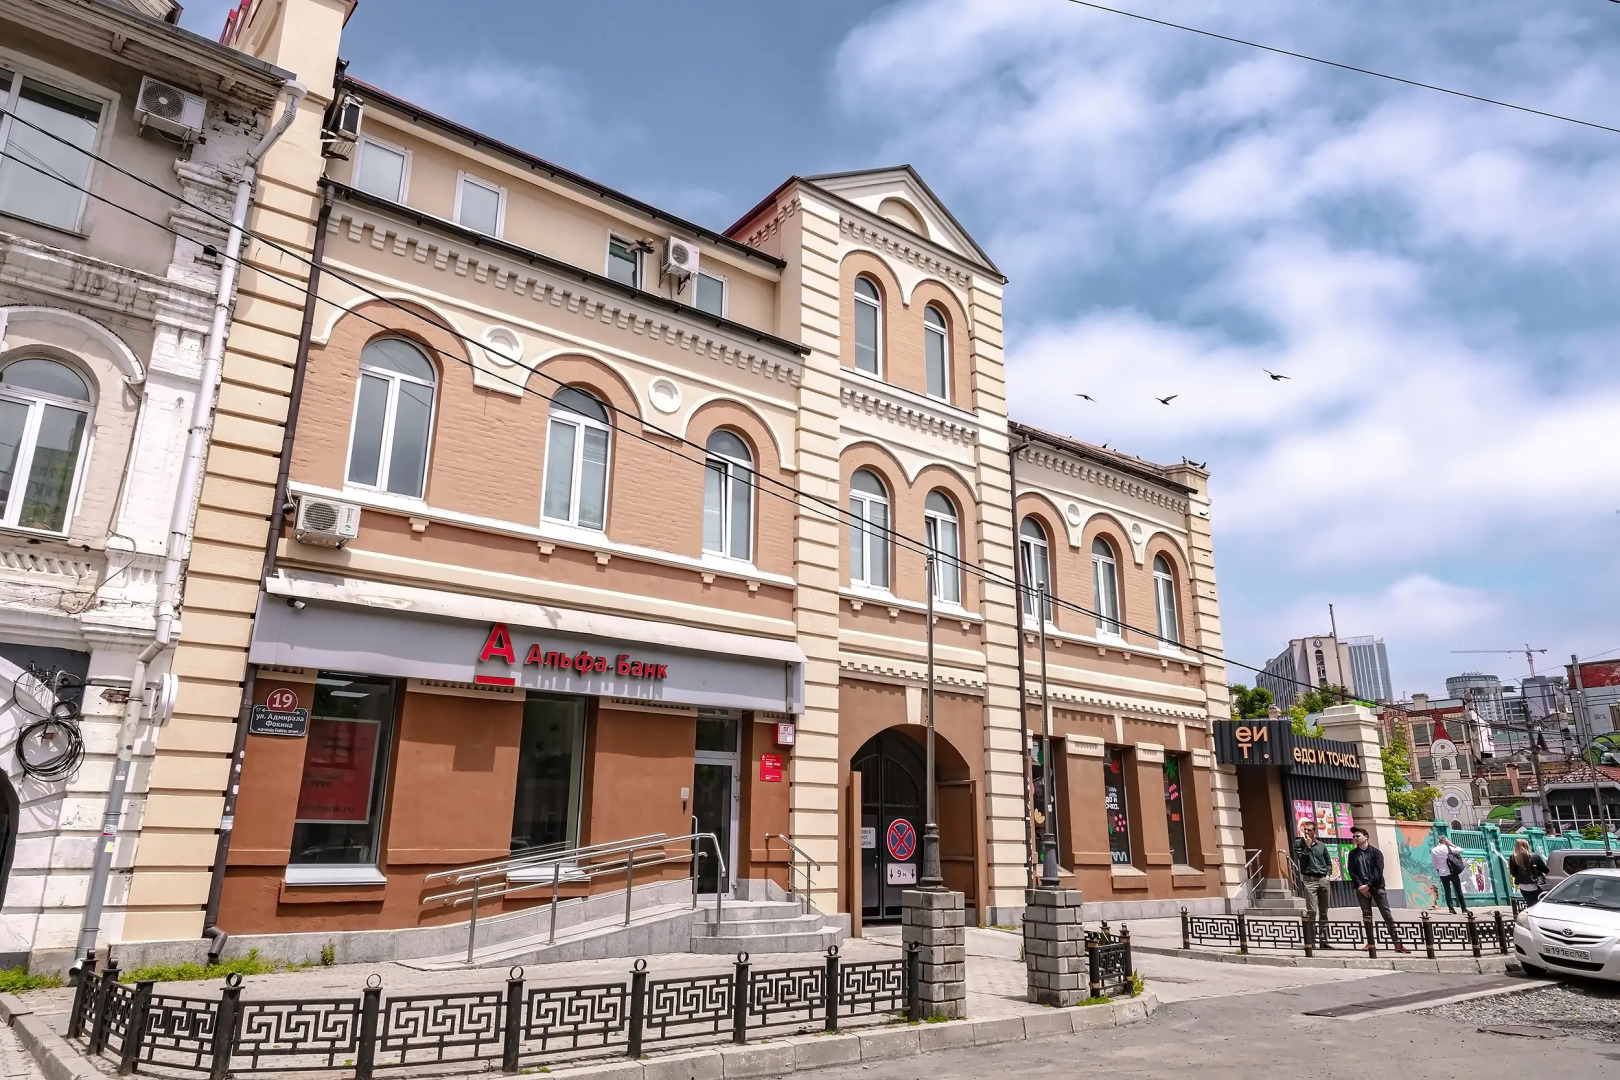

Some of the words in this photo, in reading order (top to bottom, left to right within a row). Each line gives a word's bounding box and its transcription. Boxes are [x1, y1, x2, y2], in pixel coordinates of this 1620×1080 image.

[272, 693, 293, 708] 19
[267, 713, 304, 722] Адмирала
[265, 720, 293, 728] Фокина
[1235, 726, 1268, 742] еи
[1293, 746, 1316, 765] еда
[1318, 750, 1325, 765] и
[1326, 751, 1360, 769] точка.
[897, 869, 902, 878] 9
